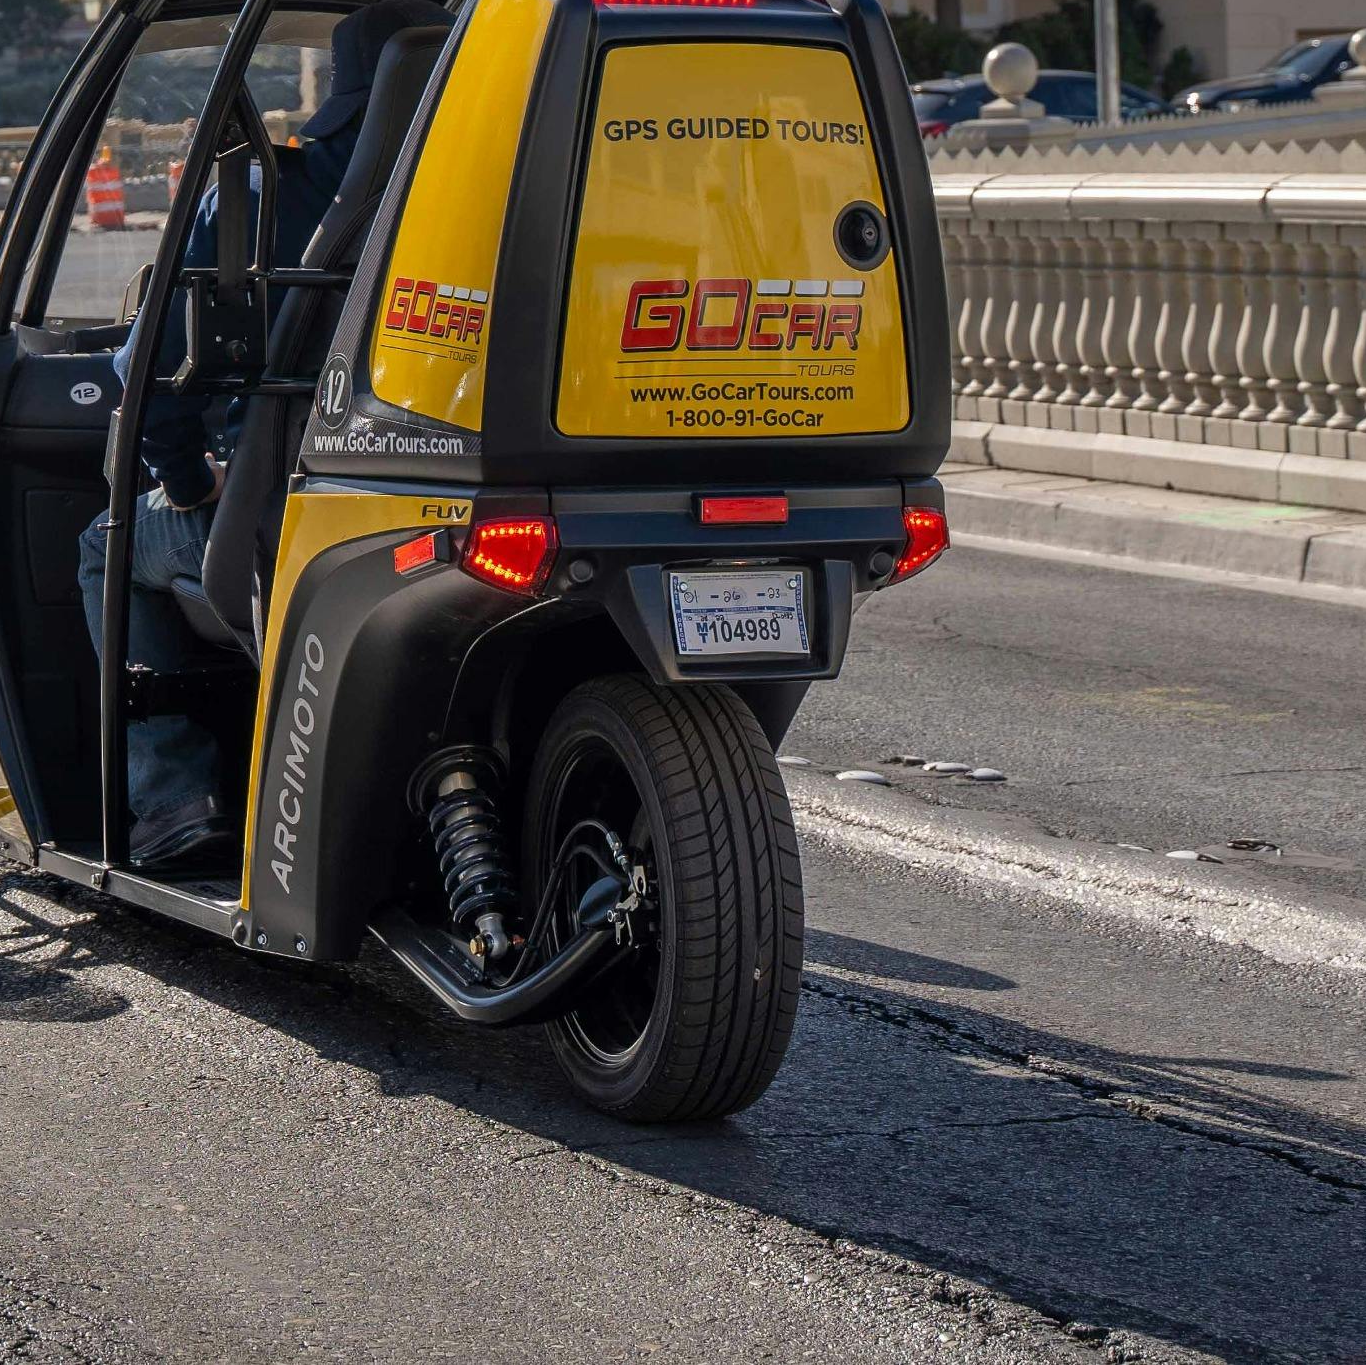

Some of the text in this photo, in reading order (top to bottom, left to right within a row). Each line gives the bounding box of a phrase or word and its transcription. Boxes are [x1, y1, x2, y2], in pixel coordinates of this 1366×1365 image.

[603, 117, 865, 145] GPS GUIDED TOURS!
[447, 349, 479, 365] TOURS
[798, 364, 857, 377] TOURS
[74, 388, 95, 399] 12
[326, 369, 344, 416] 12
[630, 382, 854, 403] www.GoCarTours.com
[666, 408, 824, 428] 1-800-91-GoCar
[314, 432, 464, 455] www.GoCarTours.com
[421, 504, 469, 521] FUV
[709, 618, 781, 643] 104989
[271, 633, 325, 894] ARCIMOTO
